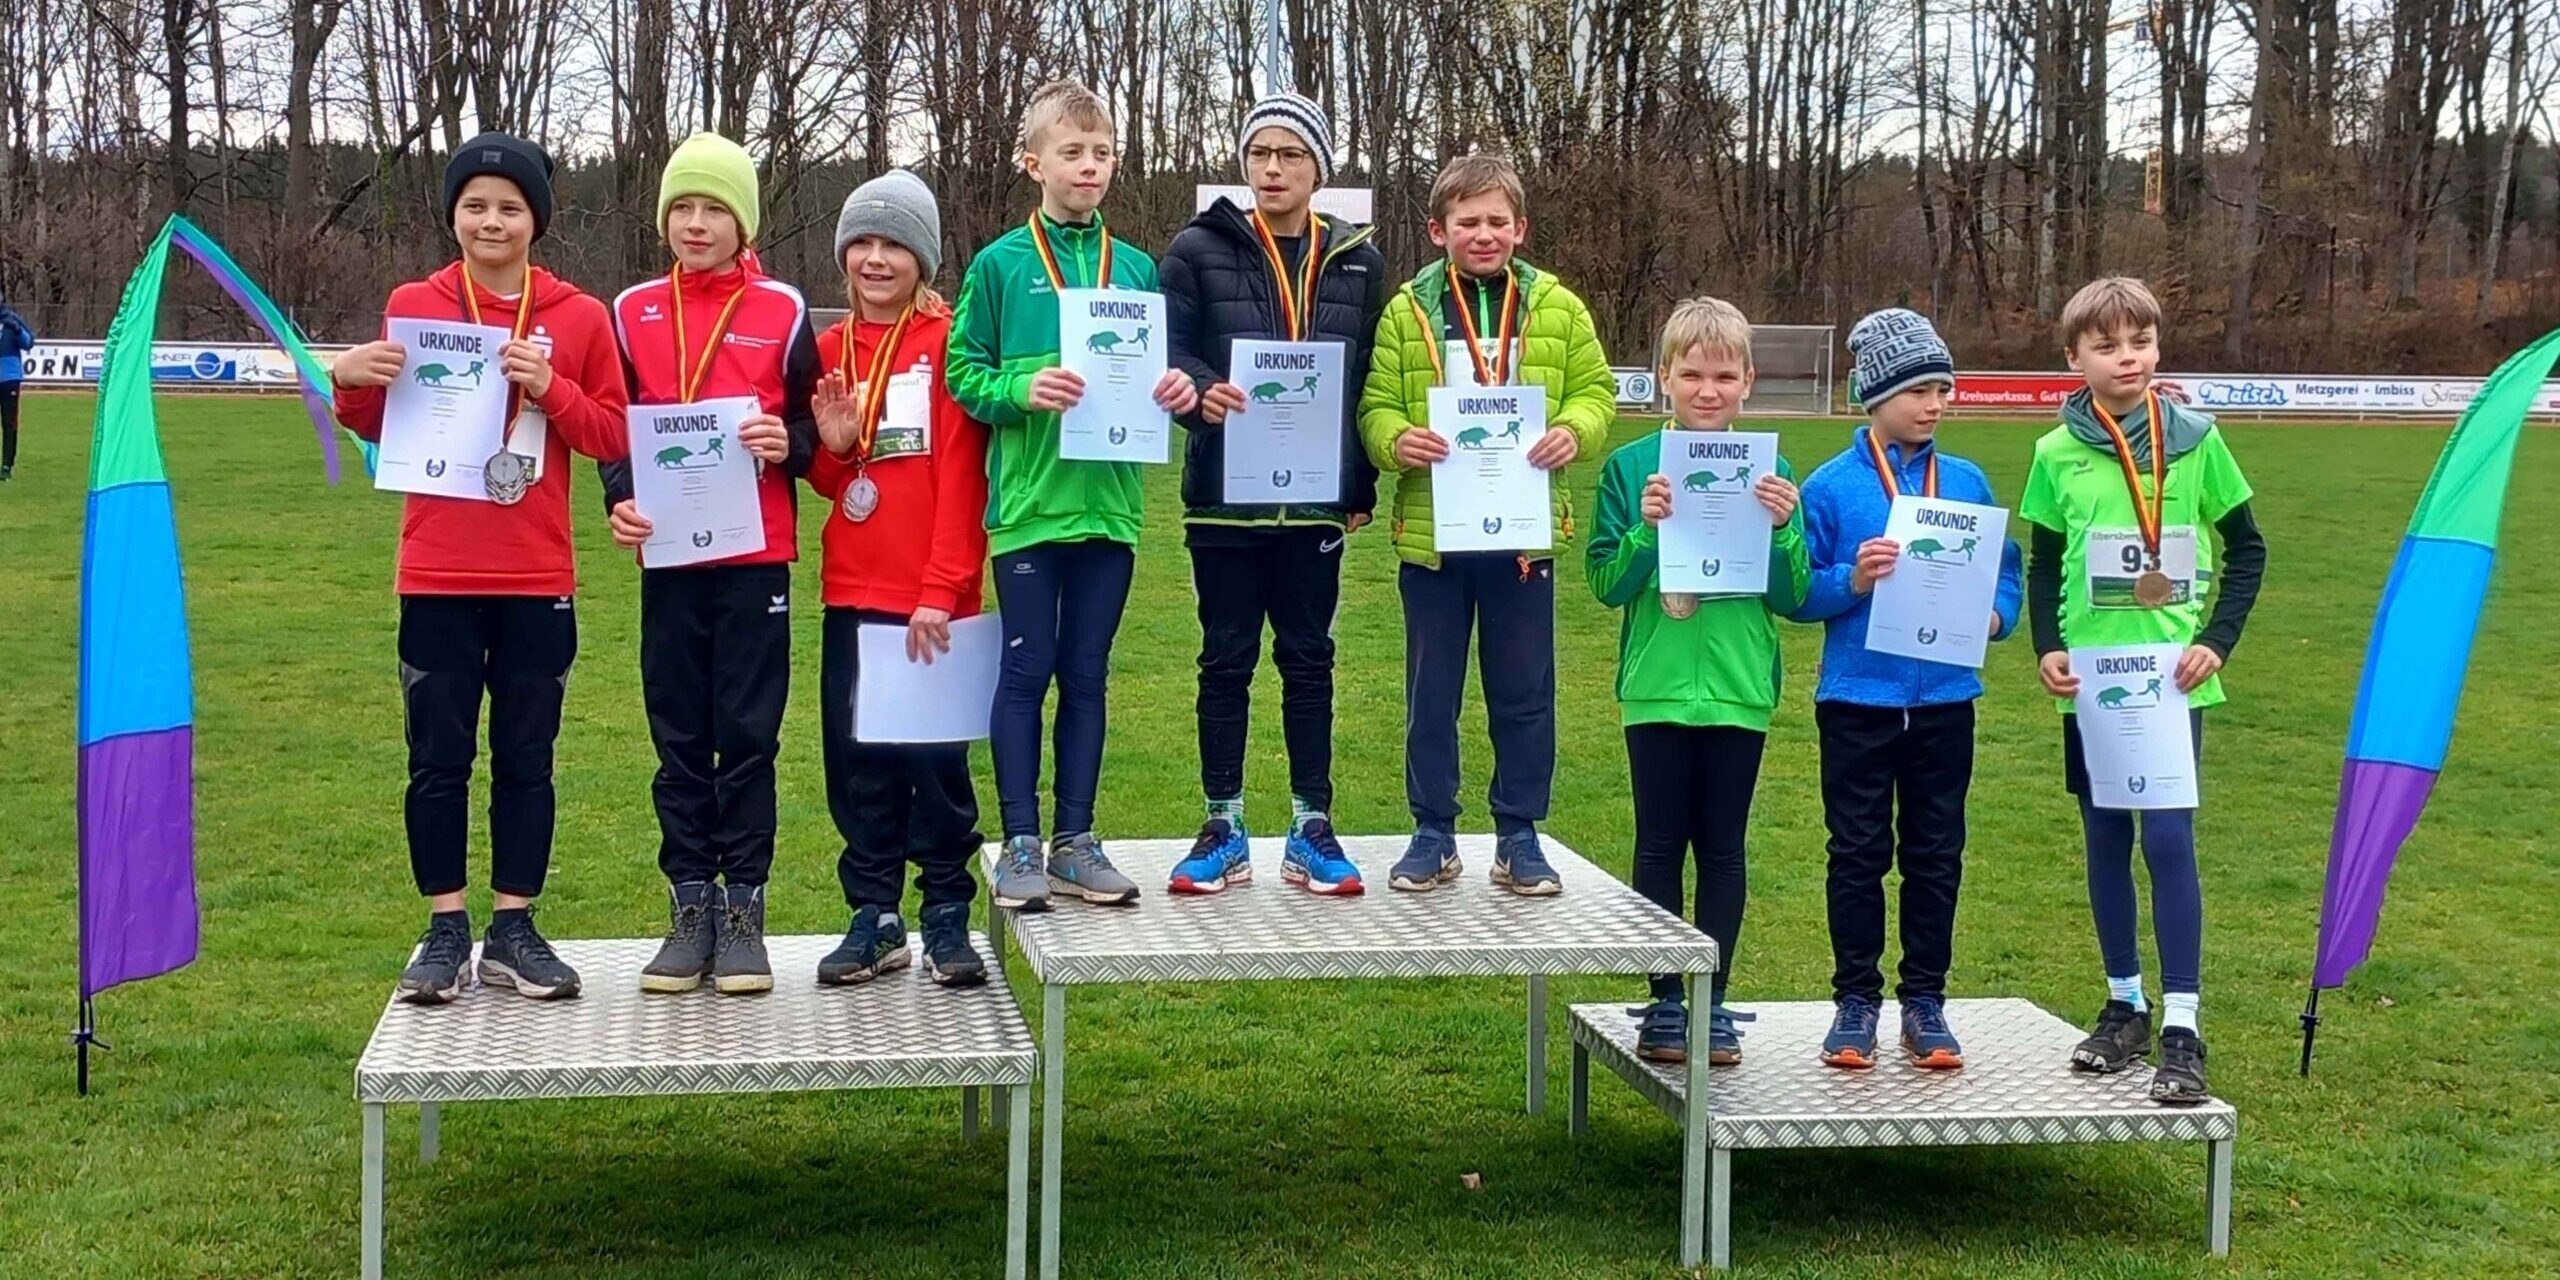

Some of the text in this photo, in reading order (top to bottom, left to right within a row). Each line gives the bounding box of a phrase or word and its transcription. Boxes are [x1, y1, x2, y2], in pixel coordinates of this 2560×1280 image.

[1090, 301, 1147, 321] URKUNDE
[419, 331, 483, 354] URKUNDE
[1254, 352, 1316, 370] URKUNDE
[2199, 382, 2288, 405] Maisch
[2295, 383, 2359, 398] Metzgerei
[2375, 384, 2415, 396] Imbiss
[1458, 398, 1518, 415] URKUNDE
[654, 414, 718, 434] URKUNDE
[1689, 442, 1749, 460] URKUNDE
[1916, 508, 1978, 532] URKUNDE
[2121, 544, 2162, 573] 93
[2096, 656, 2157, 676] URKUNDE
